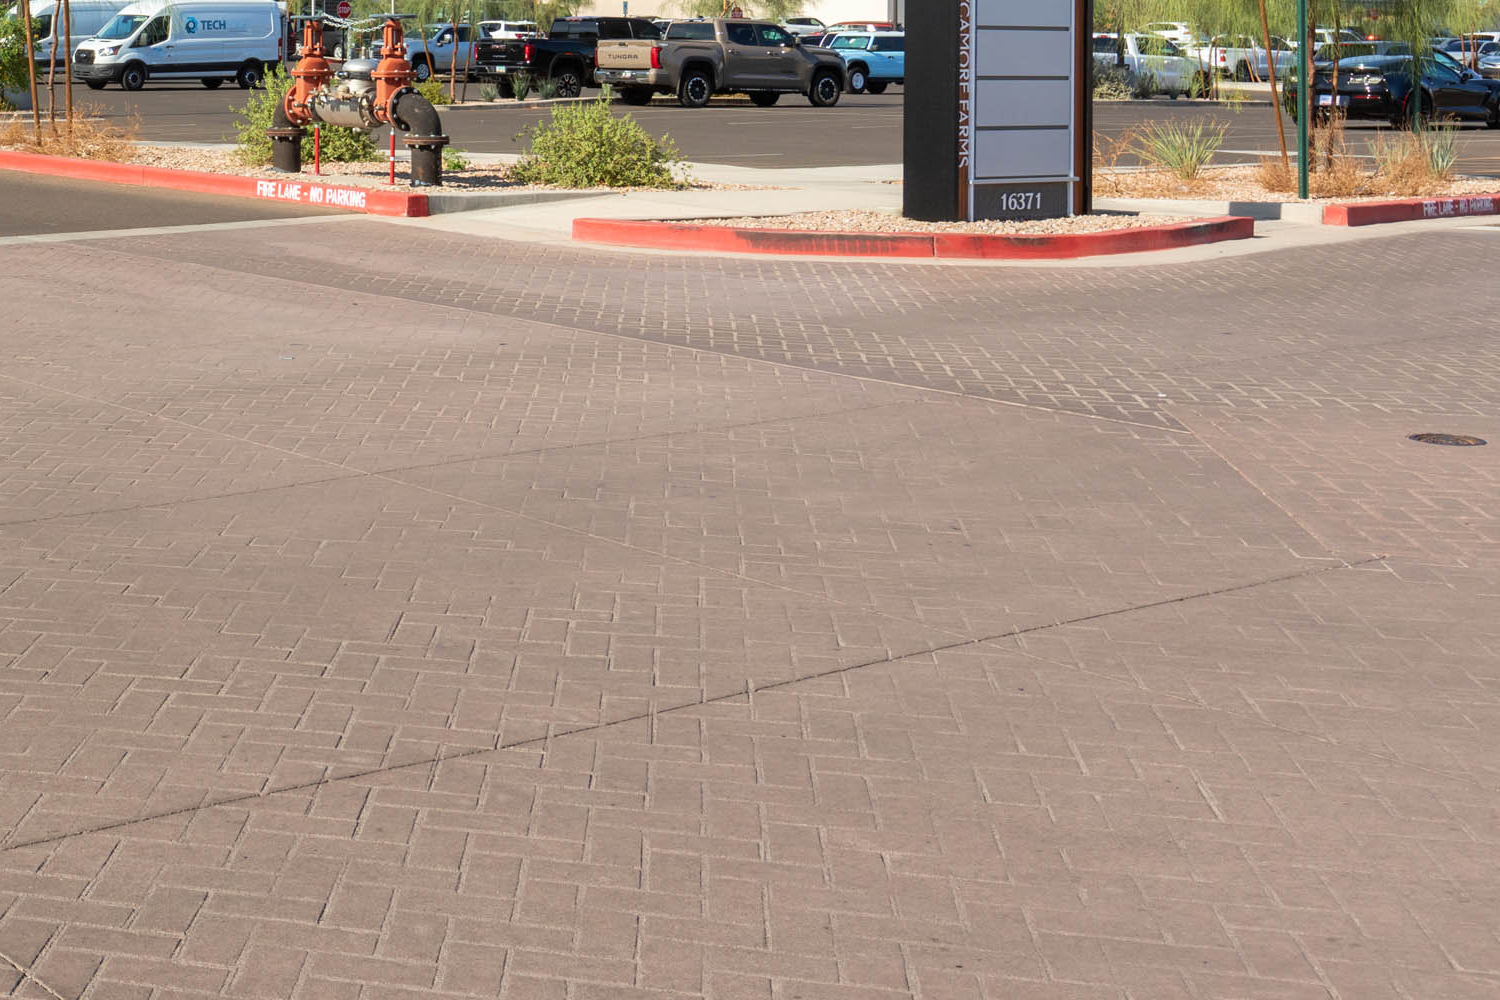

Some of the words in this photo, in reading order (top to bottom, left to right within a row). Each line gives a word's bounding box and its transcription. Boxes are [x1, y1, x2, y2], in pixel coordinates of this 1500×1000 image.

[200, 20, 227, 31] TECH
[958, 100, 969, 168] FARMS
[257, 180, 277, 198] FIRE
[278, 183, 301, 200] LANE
[310, 186, 323, 203] NO
[326, 188, 366, 208] PARKING
[1001, 192, 1041, 210] 16371
